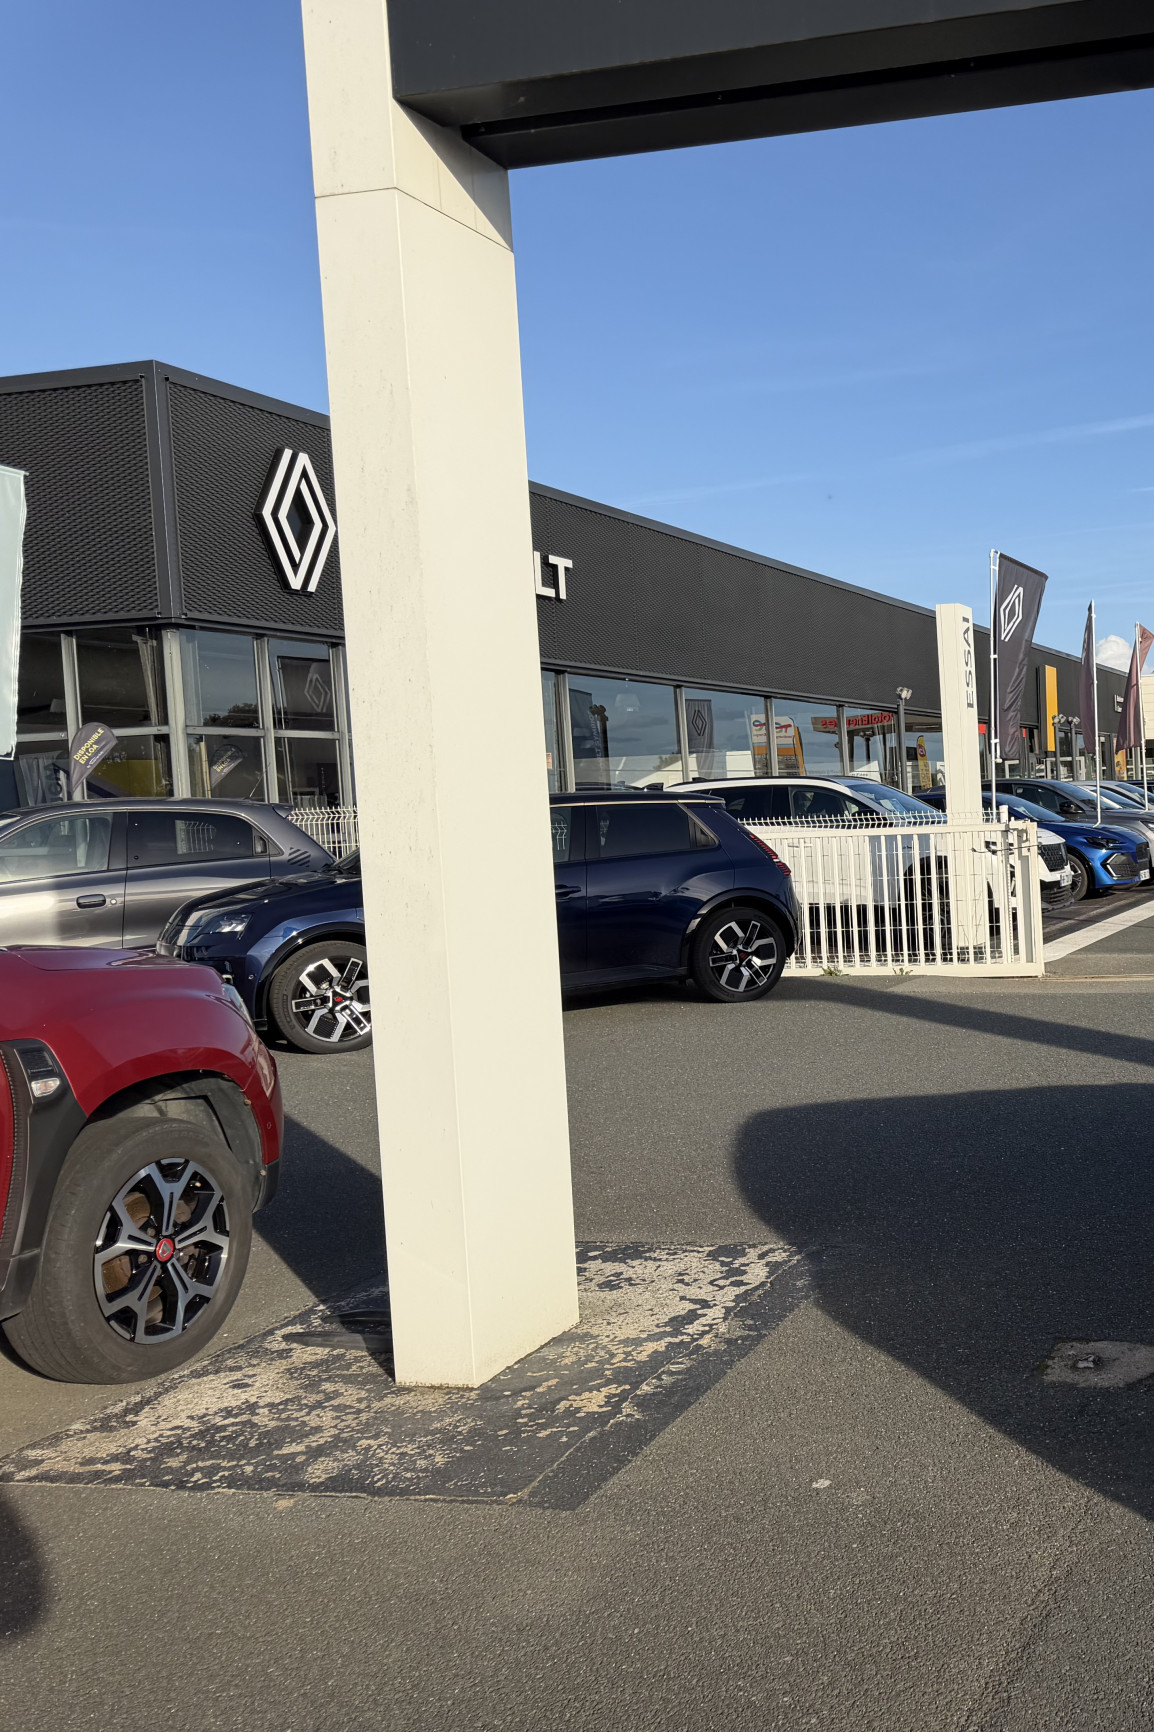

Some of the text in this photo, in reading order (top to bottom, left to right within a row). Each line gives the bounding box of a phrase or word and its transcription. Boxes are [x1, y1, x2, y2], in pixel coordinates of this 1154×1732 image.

[962, 616, 974, 709] ESSAI
[73, 727, 105, 761] DISPONIBLE
[78, 753, 90, 765] EN
[85, 743, 99, 758] LOA
